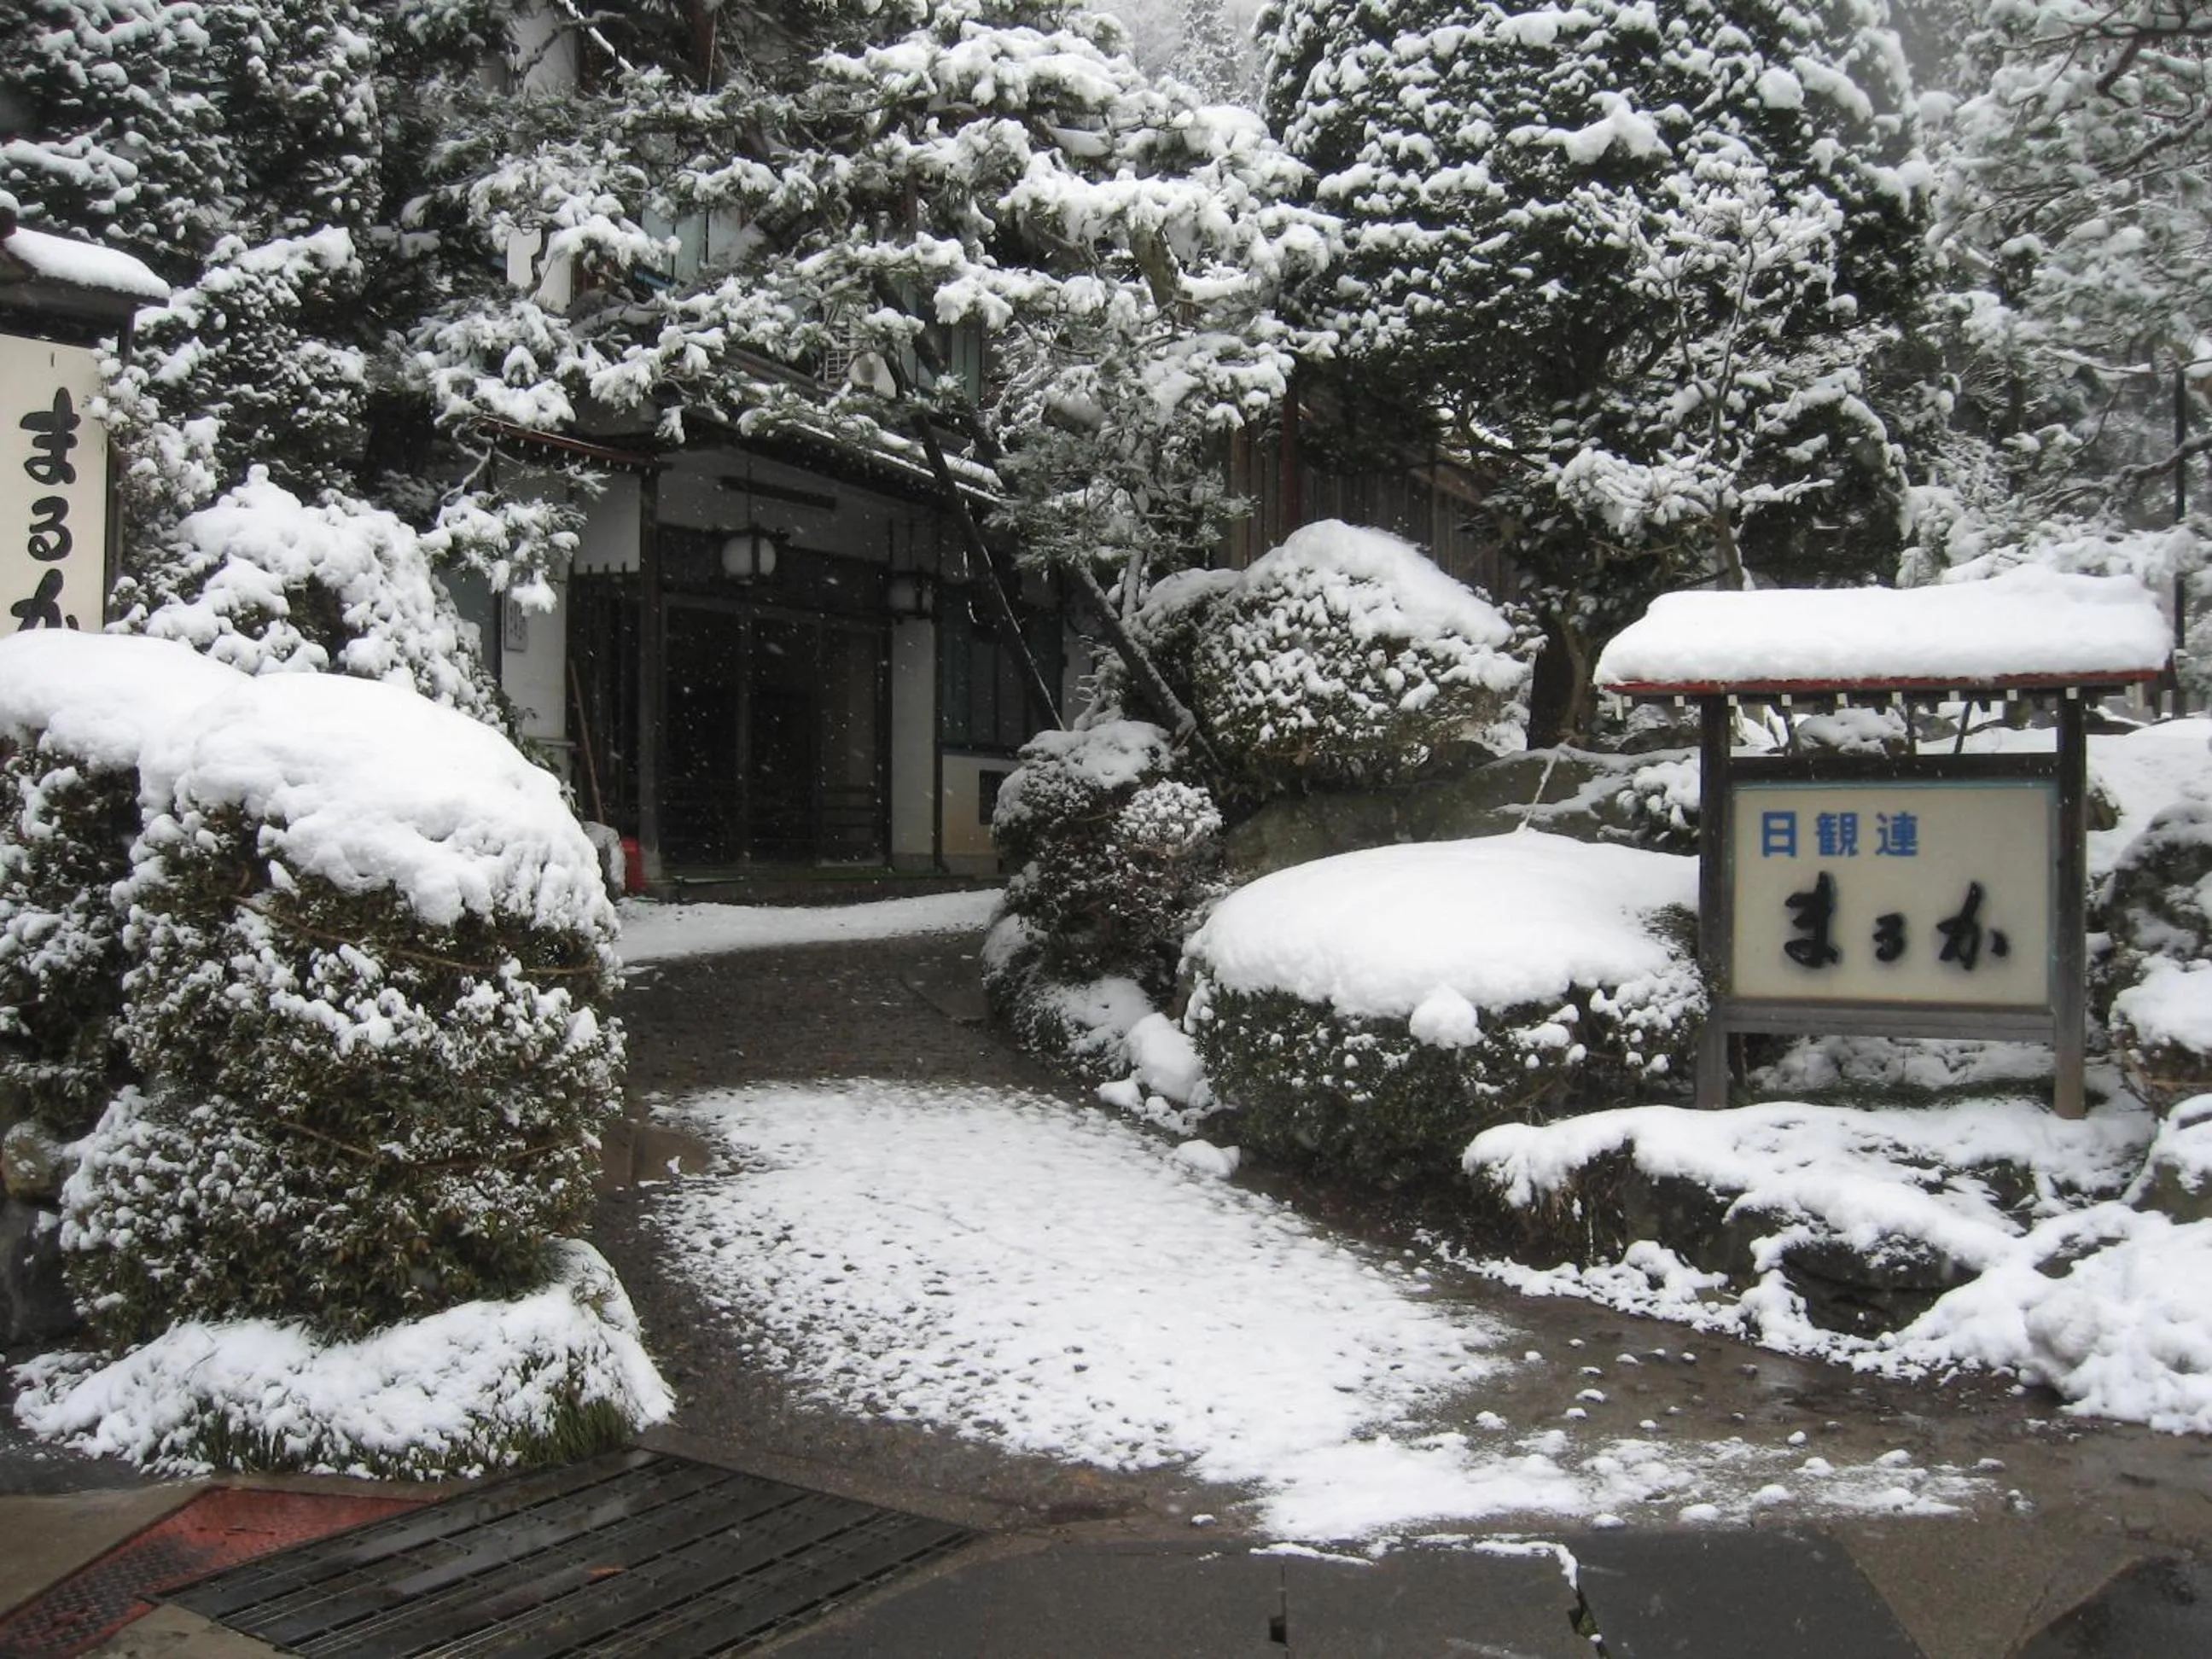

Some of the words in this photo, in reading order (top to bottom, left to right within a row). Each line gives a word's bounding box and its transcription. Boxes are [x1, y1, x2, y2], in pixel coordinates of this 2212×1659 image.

[10, 387, 81, 632] まるか
[1761, 811, 1919, 858] 日観連
[1784, 870, 2009, 971] まるか
